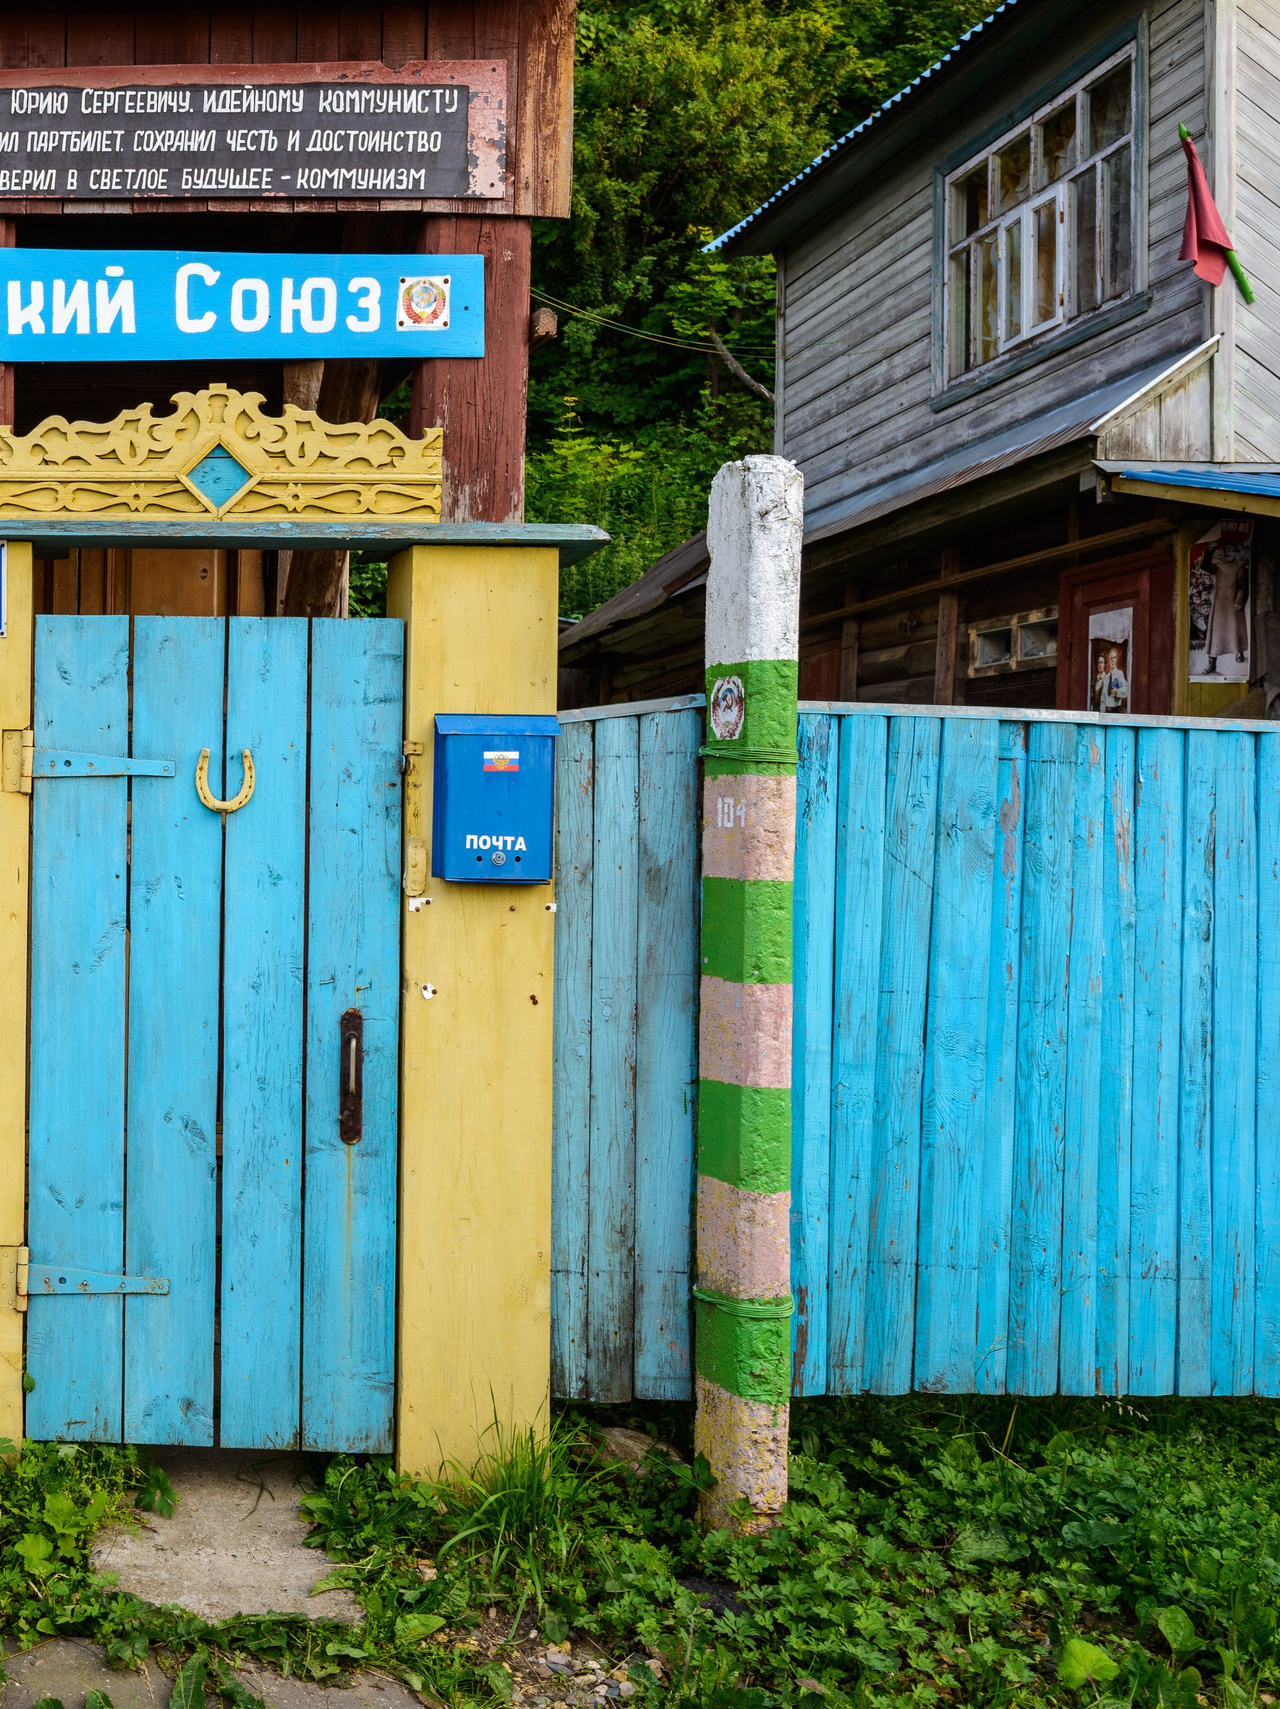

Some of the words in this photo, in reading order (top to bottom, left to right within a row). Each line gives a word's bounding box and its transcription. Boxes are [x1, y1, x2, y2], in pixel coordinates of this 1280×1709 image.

[11, 89, 68, 114] ЮРИЮ
[203, 85, 304, 113] ИДЕЙНОМУ
[319, 89, 458, 113] КОММУНИСТУ
[133, 129, 216, 152] СОХРАНИЛ
[226, 130, 278, 152] ЧЕСТЬ
[287, 130, 300, 152] И
[305, 130, 442, 152] ДОСТОИНСТВО
[67, 169, 78, 190] В
[89, 169, 169, 190] СВЕТЛОЕ
[181, 168, 273, 190] БУДУЩЕЕ
[297, 168, 426, 190] КОММУНИЗМ
[465, 834, 527, 851] ПОЧТА
